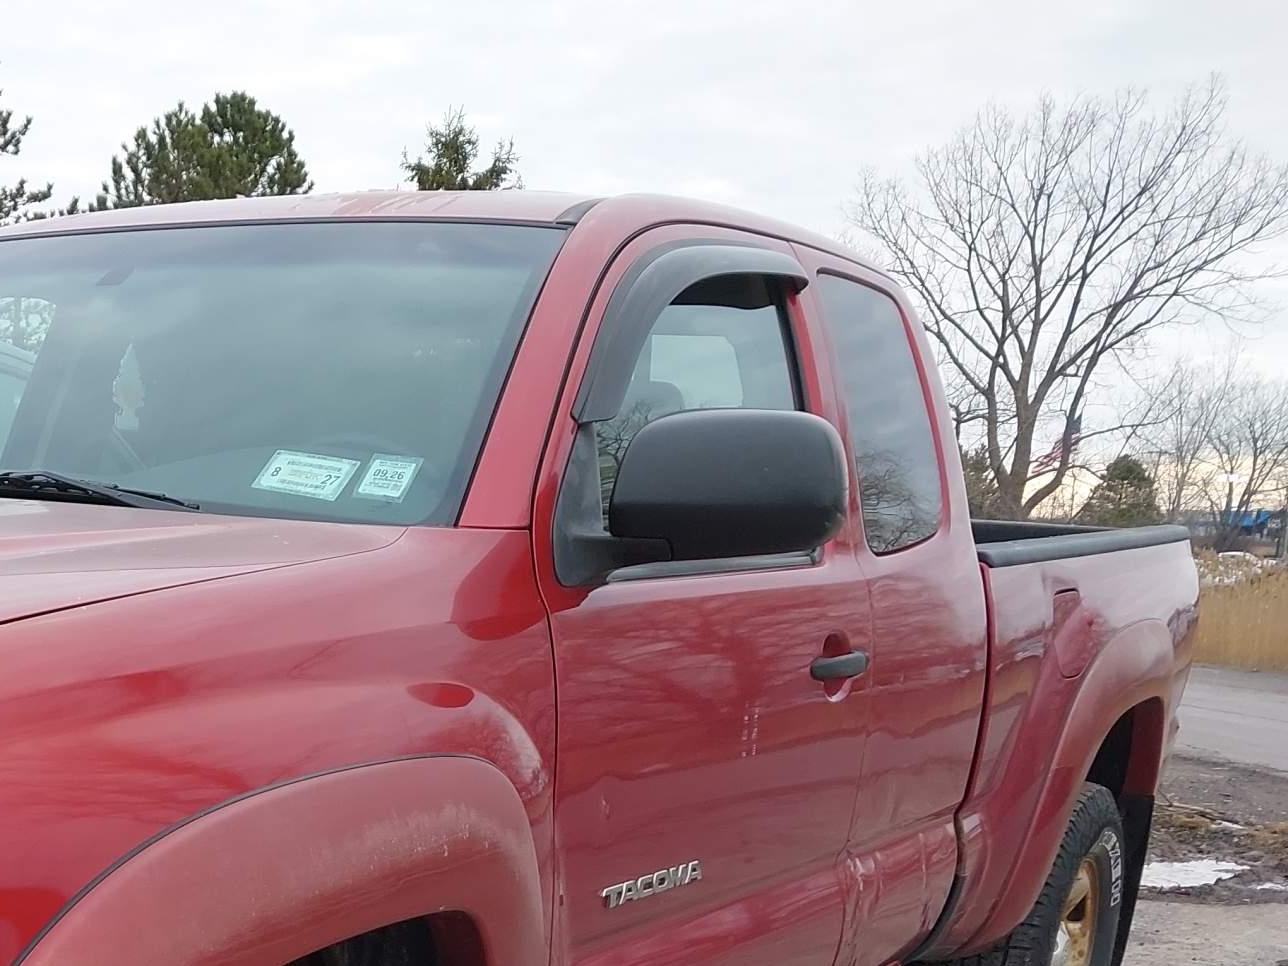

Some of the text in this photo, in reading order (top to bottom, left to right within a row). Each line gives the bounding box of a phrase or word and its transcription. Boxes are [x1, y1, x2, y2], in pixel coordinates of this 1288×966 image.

[271, 466, 282, 477] 8
[320, 473, 341, 486] 27
[600, 860, 702, 908] TACOMA
